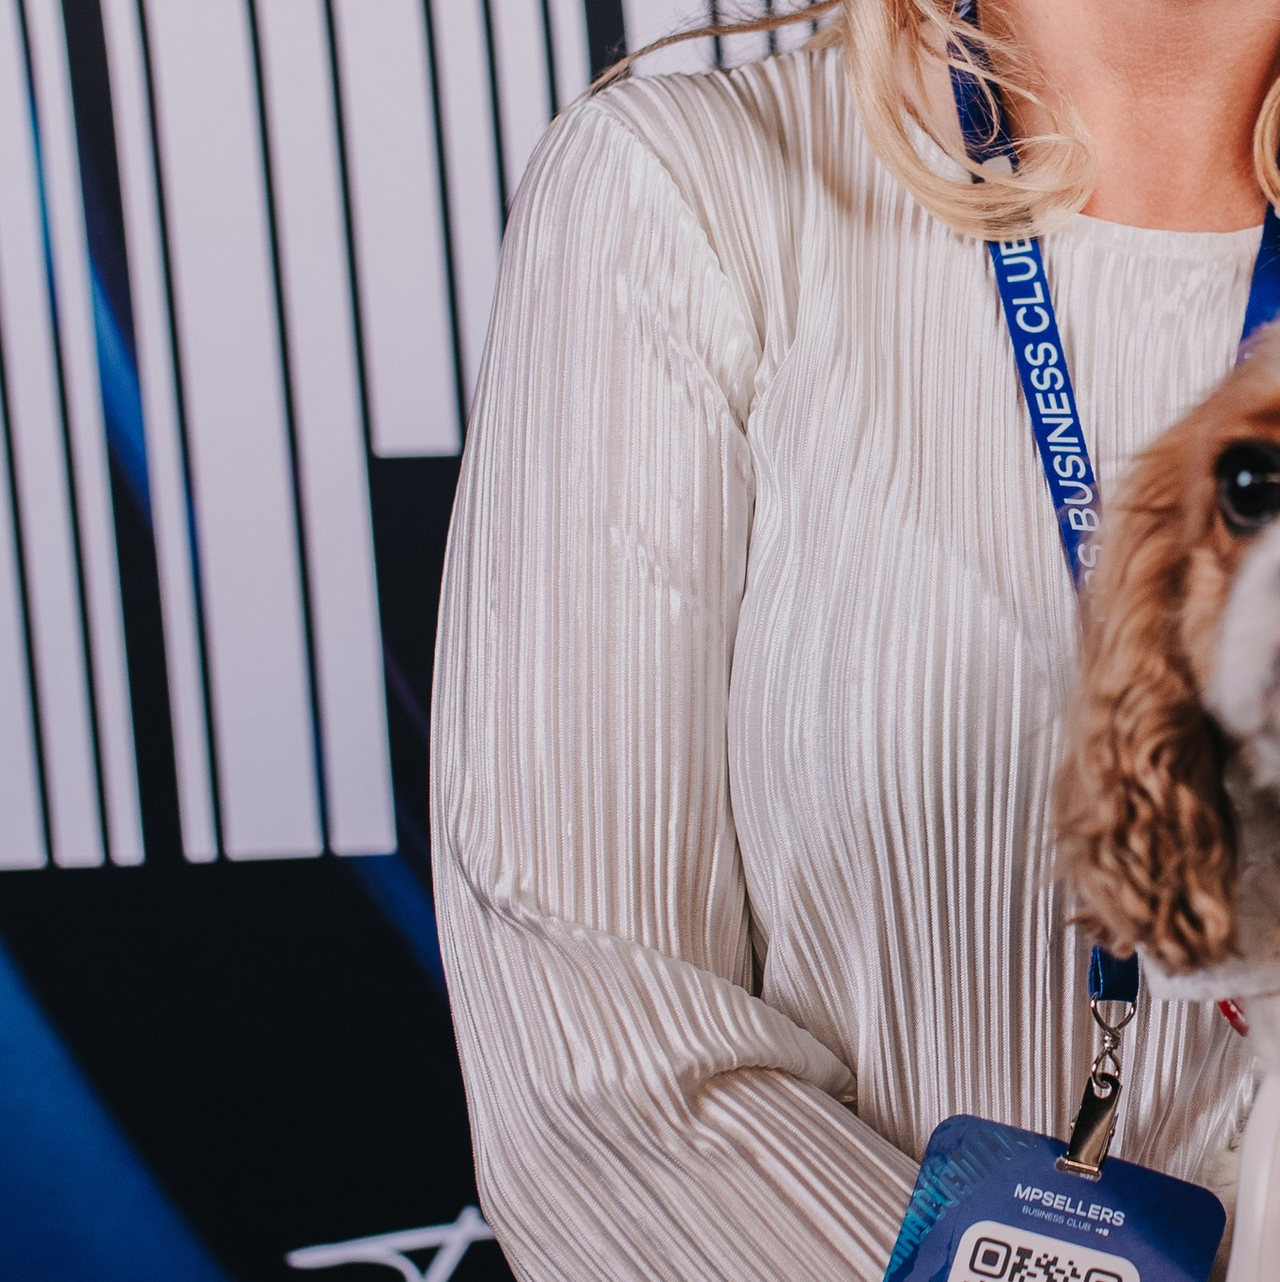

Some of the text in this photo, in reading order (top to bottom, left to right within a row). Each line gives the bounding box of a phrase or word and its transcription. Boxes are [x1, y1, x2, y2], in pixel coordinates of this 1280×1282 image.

[1025, 341, 1100, 532] BUSINESS
[1013, 1182, 1126, 1227] MPSELLERS
[1021, 1204, 1092, 1232] BUSINESS CLUB
